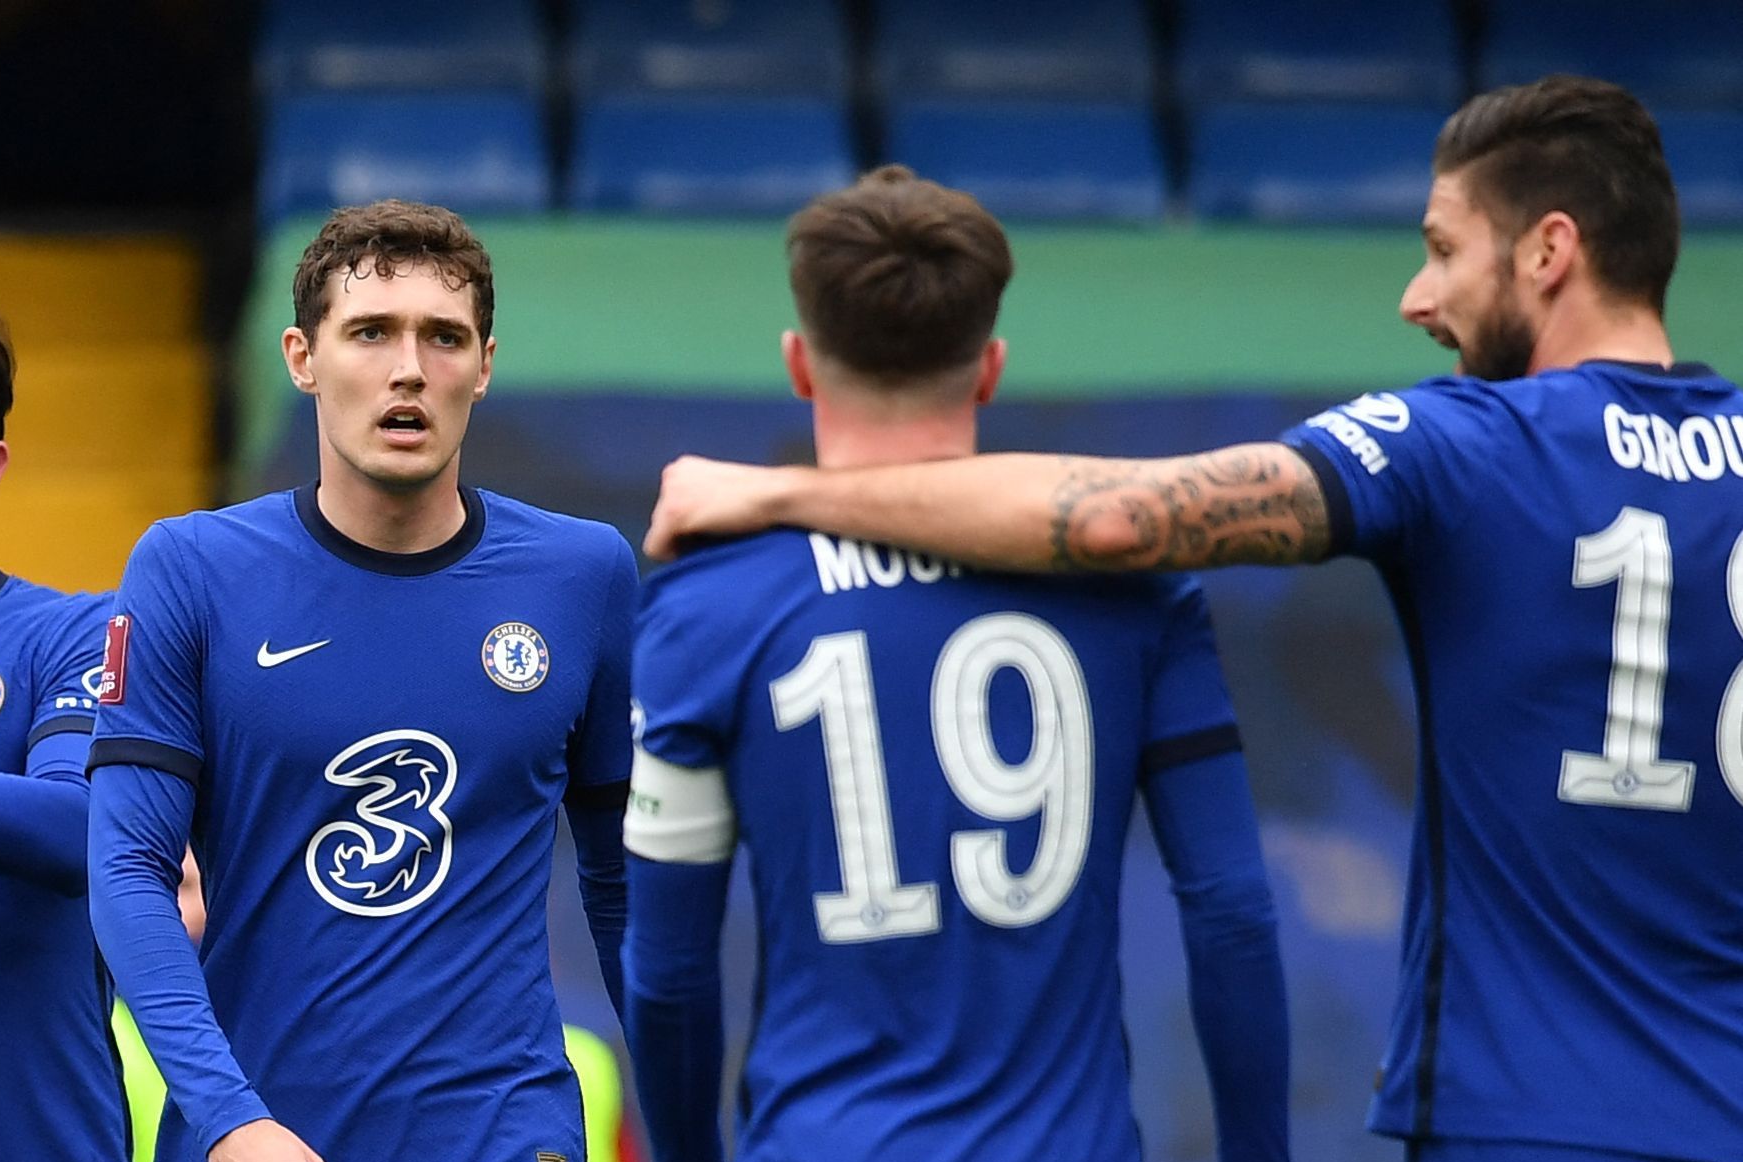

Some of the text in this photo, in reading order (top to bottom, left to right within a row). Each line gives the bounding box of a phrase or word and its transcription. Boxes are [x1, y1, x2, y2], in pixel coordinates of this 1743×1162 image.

[1603, 402, 1743, 482] GIROU
[808, 532, 961, 595] MOU
[494, 625, 537, 643] CHELSEA
[769, 611, 1096, 945] 19
